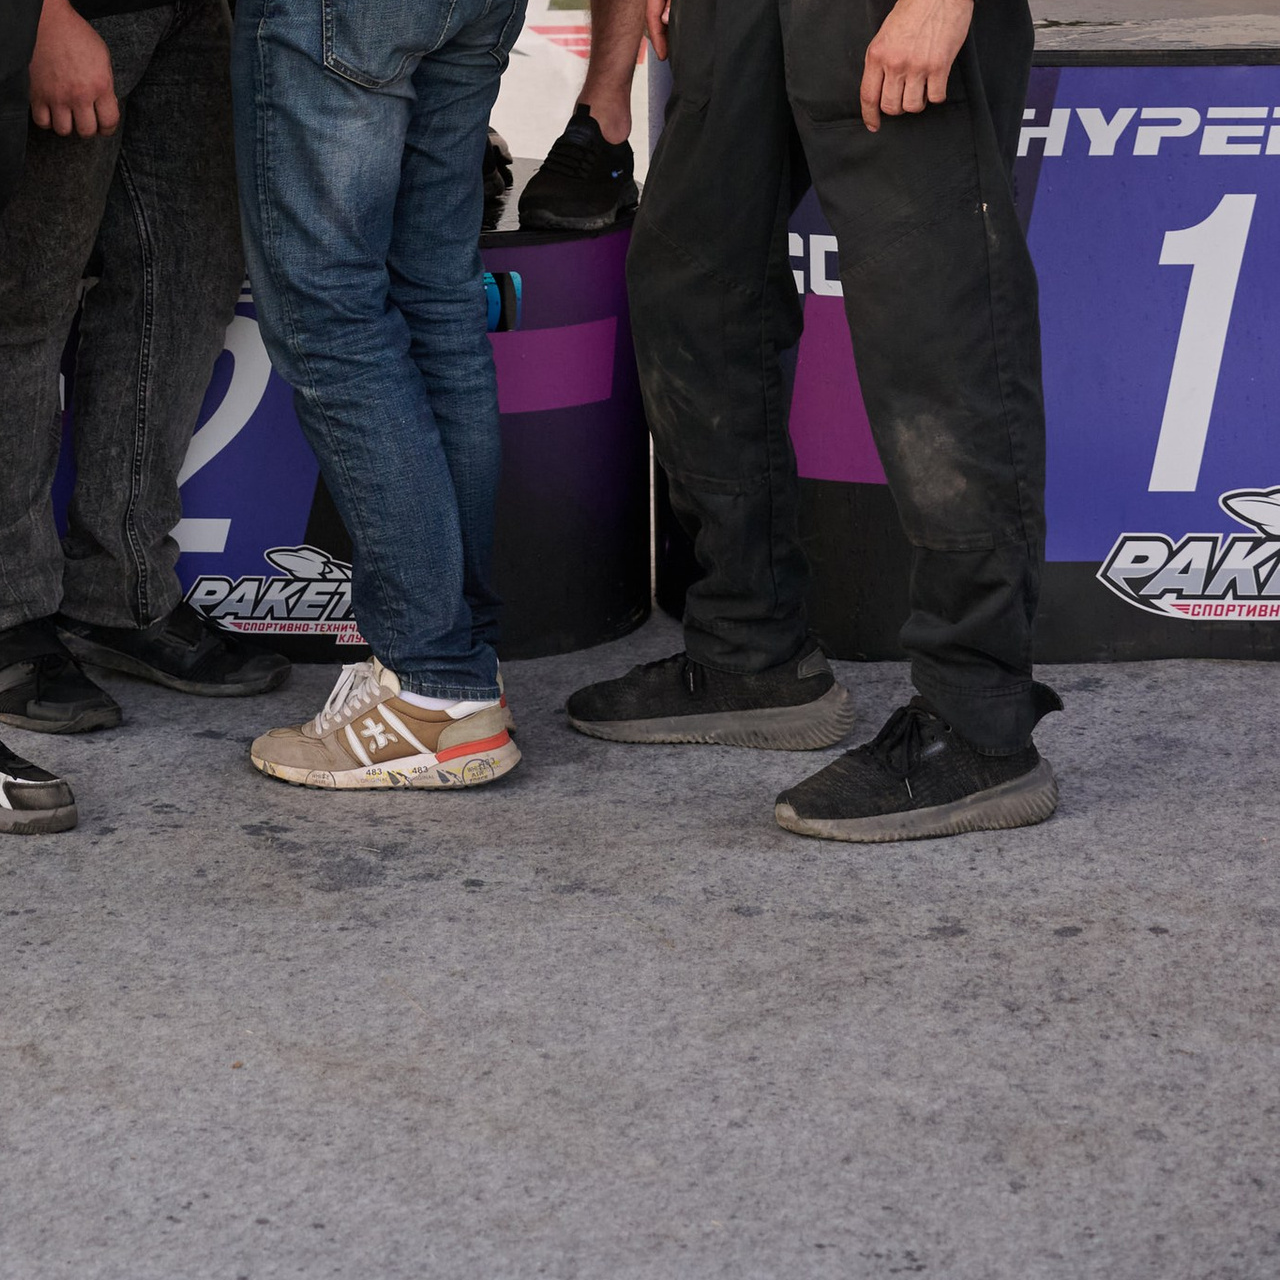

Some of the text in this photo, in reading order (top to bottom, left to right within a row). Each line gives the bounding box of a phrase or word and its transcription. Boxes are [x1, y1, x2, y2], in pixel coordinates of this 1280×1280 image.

[1017, 106, 1280, 157] HYPE
[1147, 193, 1258, 492] 1
[188, 580, 357, 619] РАКЕТ
[243, 621, 359, 633] СПОРТИВНО-ТЕХНИЧ
[365, 768, 383, 777] 483
[411, 765, 429, 775] 483
